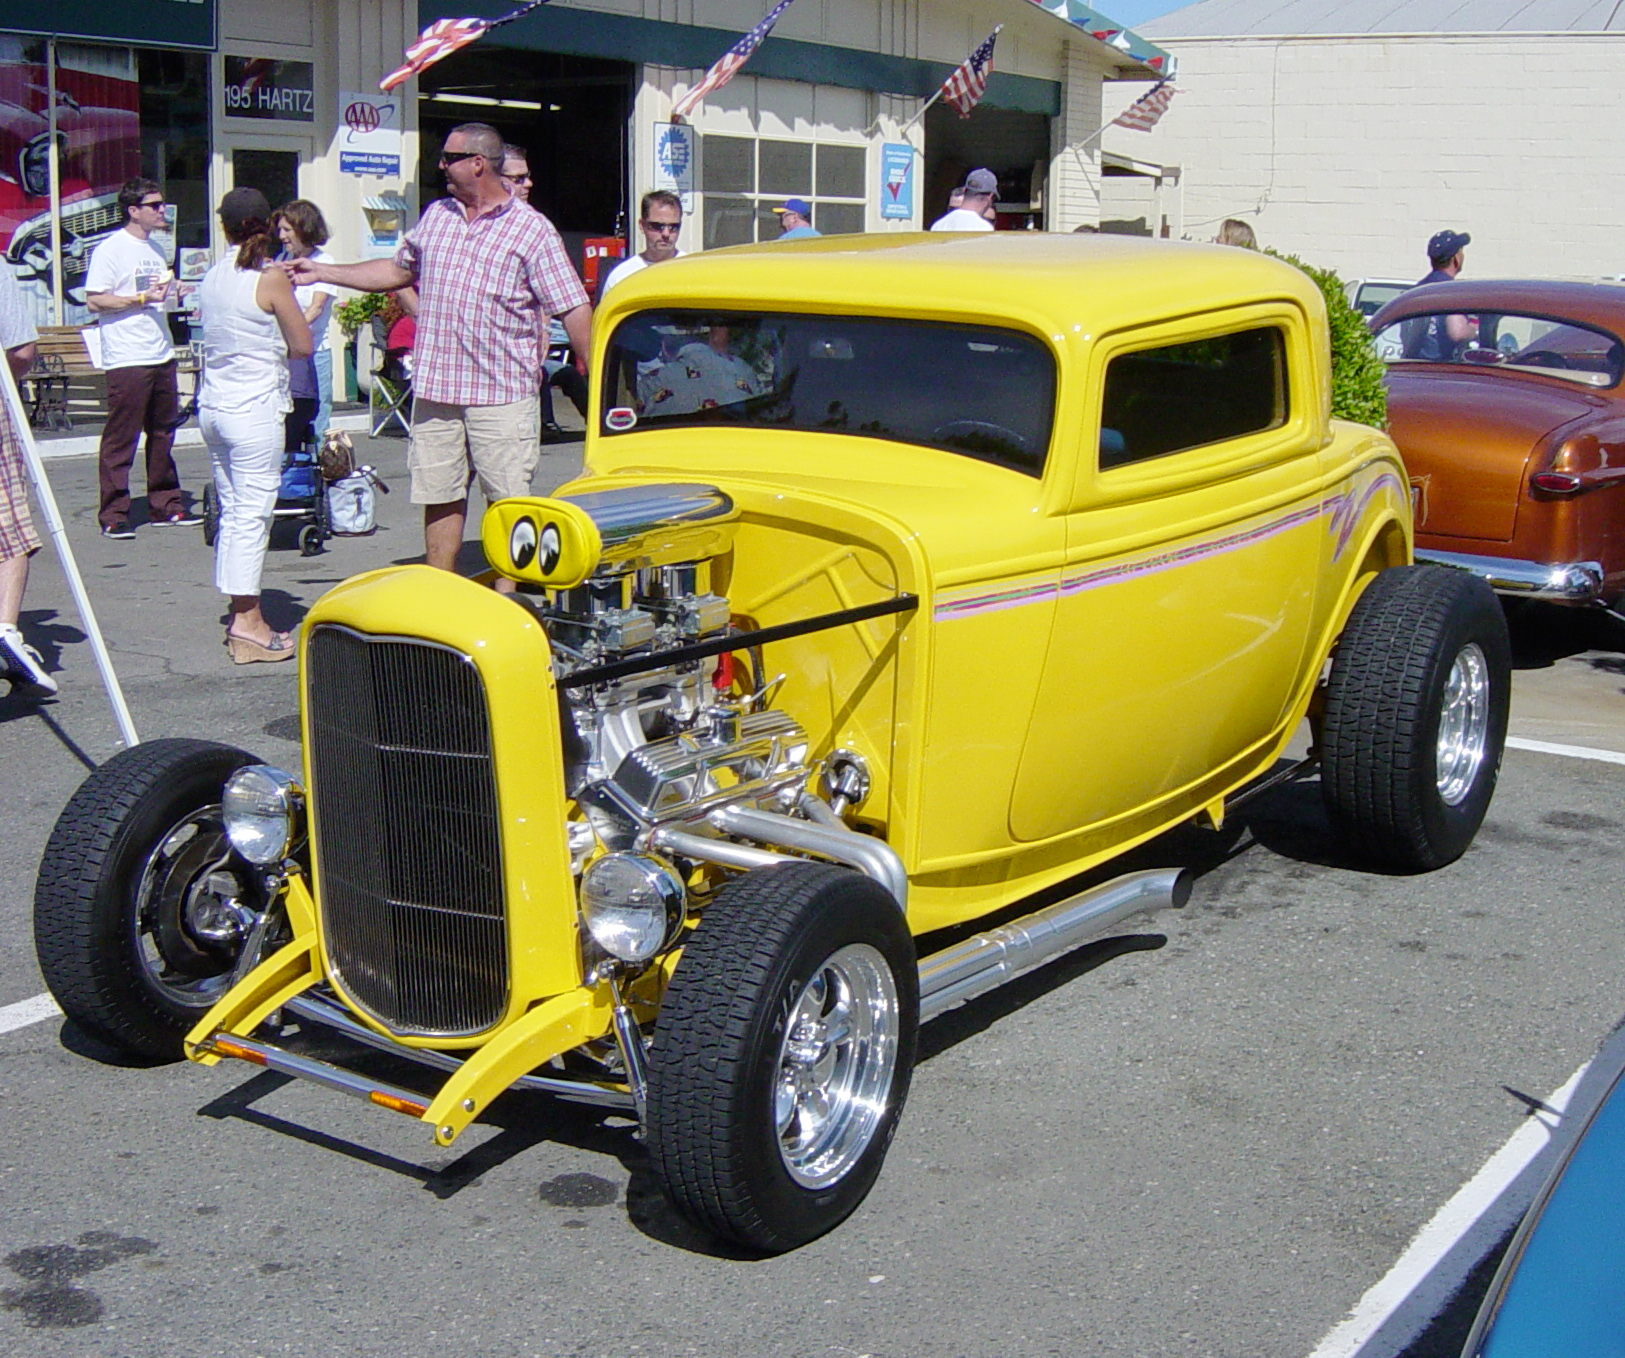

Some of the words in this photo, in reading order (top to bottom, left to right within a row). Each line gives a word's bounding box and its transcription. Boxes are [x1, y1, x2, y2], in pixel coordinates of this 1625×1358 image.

[224, 85, 251, 109] 195
[258, 87, 313, 113] HARTZ
[347, 103, 378, 133] AAA
